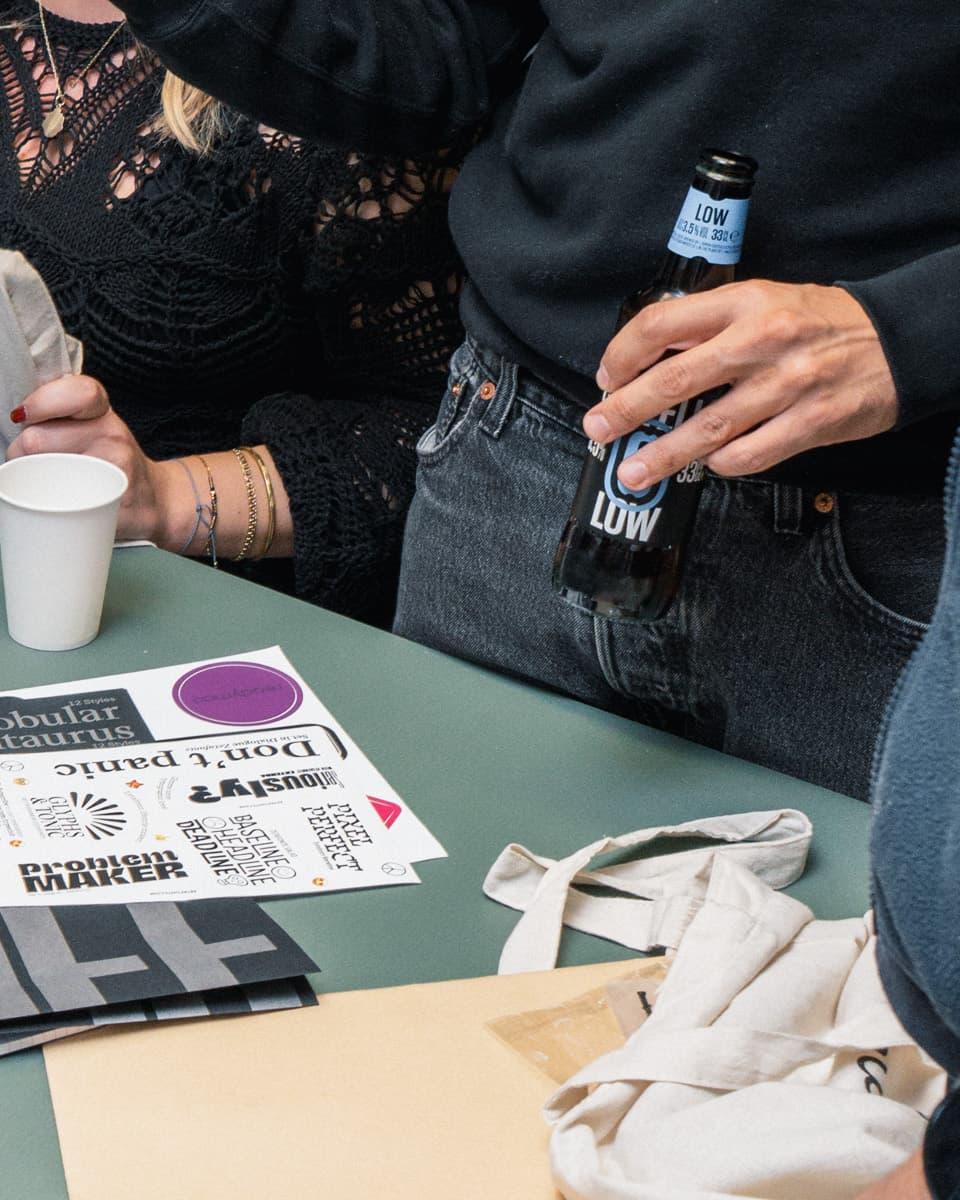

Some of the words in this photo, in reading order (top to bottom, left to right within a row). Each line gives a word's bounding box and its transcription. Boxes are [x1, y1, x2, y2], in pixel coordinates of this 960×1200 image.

[695, 202, 730, 227] LOW
[590, 490, 663, 543] LOW
[53, 749, 181, 780] panic
[186, 769, 346, 805] Seriously?
[34, 806, 69, 839] TONIC
[48, 796, 85, 840] GLYPHS
[300, 804, 365, 873] PERFECT
[325, 802, 374, 848] PIXEL
[17, 849, 179, 877] Problem
[176, 818, 242, 877] DEADLINE
[210, 828, 277, 887] HEADLINE
[228, 814, 291, 868] BASELINE
[21, 861, 190, 894] MAKER
